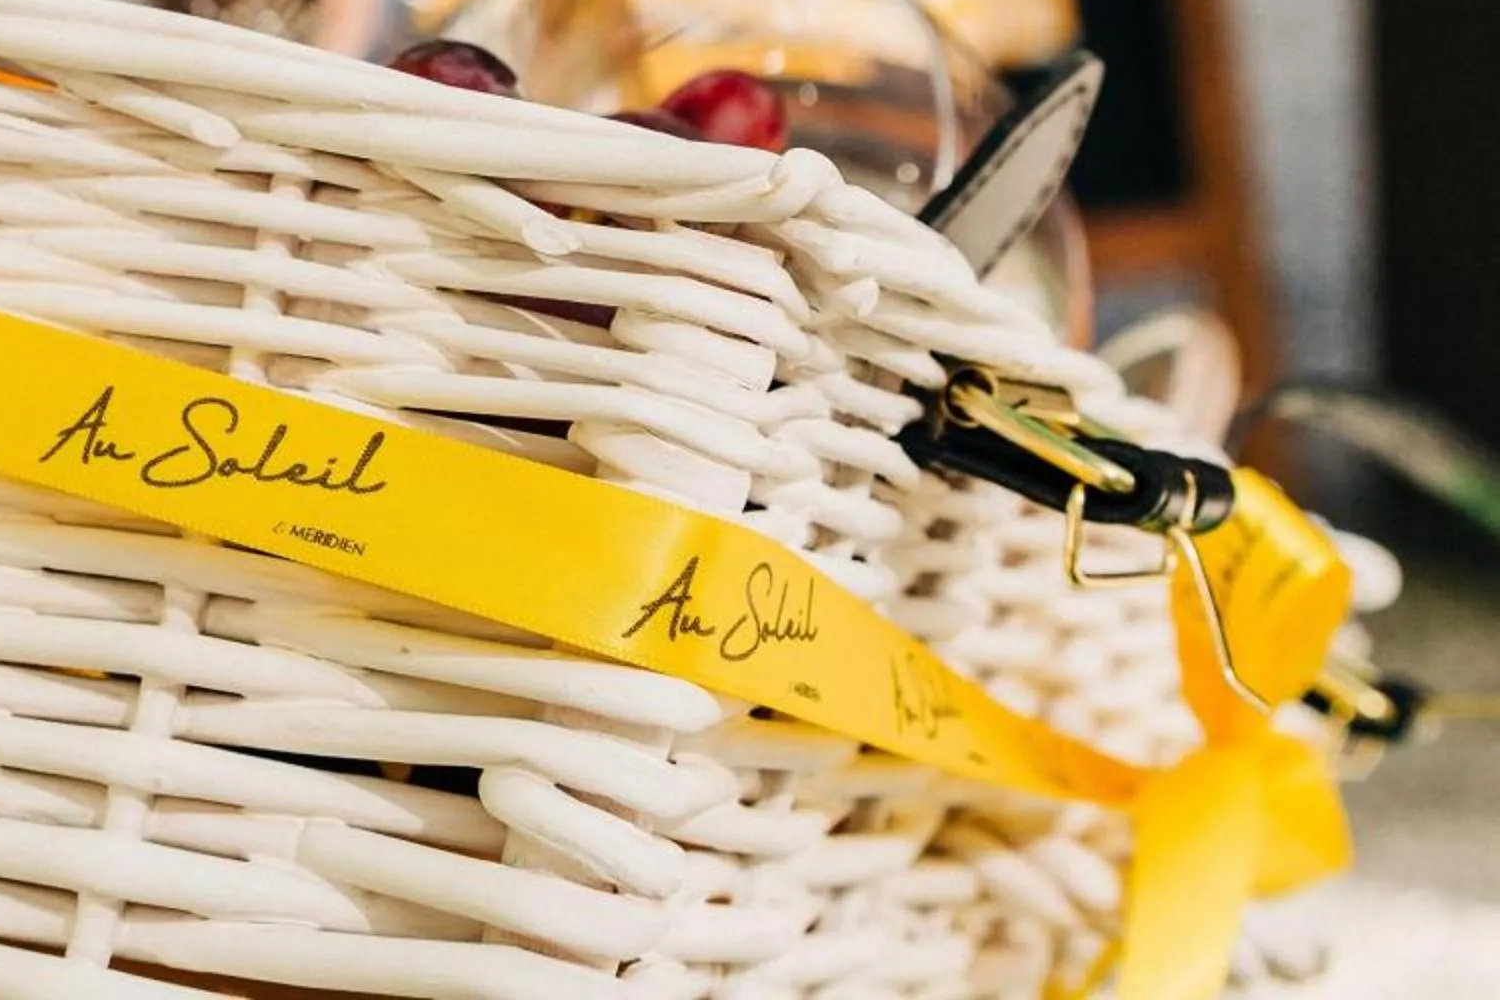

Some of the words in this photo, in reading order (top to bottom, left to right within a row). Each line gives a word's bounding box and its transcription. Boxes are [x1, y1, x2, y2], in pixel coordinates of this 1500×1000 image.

[39, 385, 136, 464] Au
[141, 397, 386, 495] Soleil
[288, 524, 367, 556] MERIDIEN
[622, 556, 715, 642] Au
[720, 561, 819, 662] Soleil
